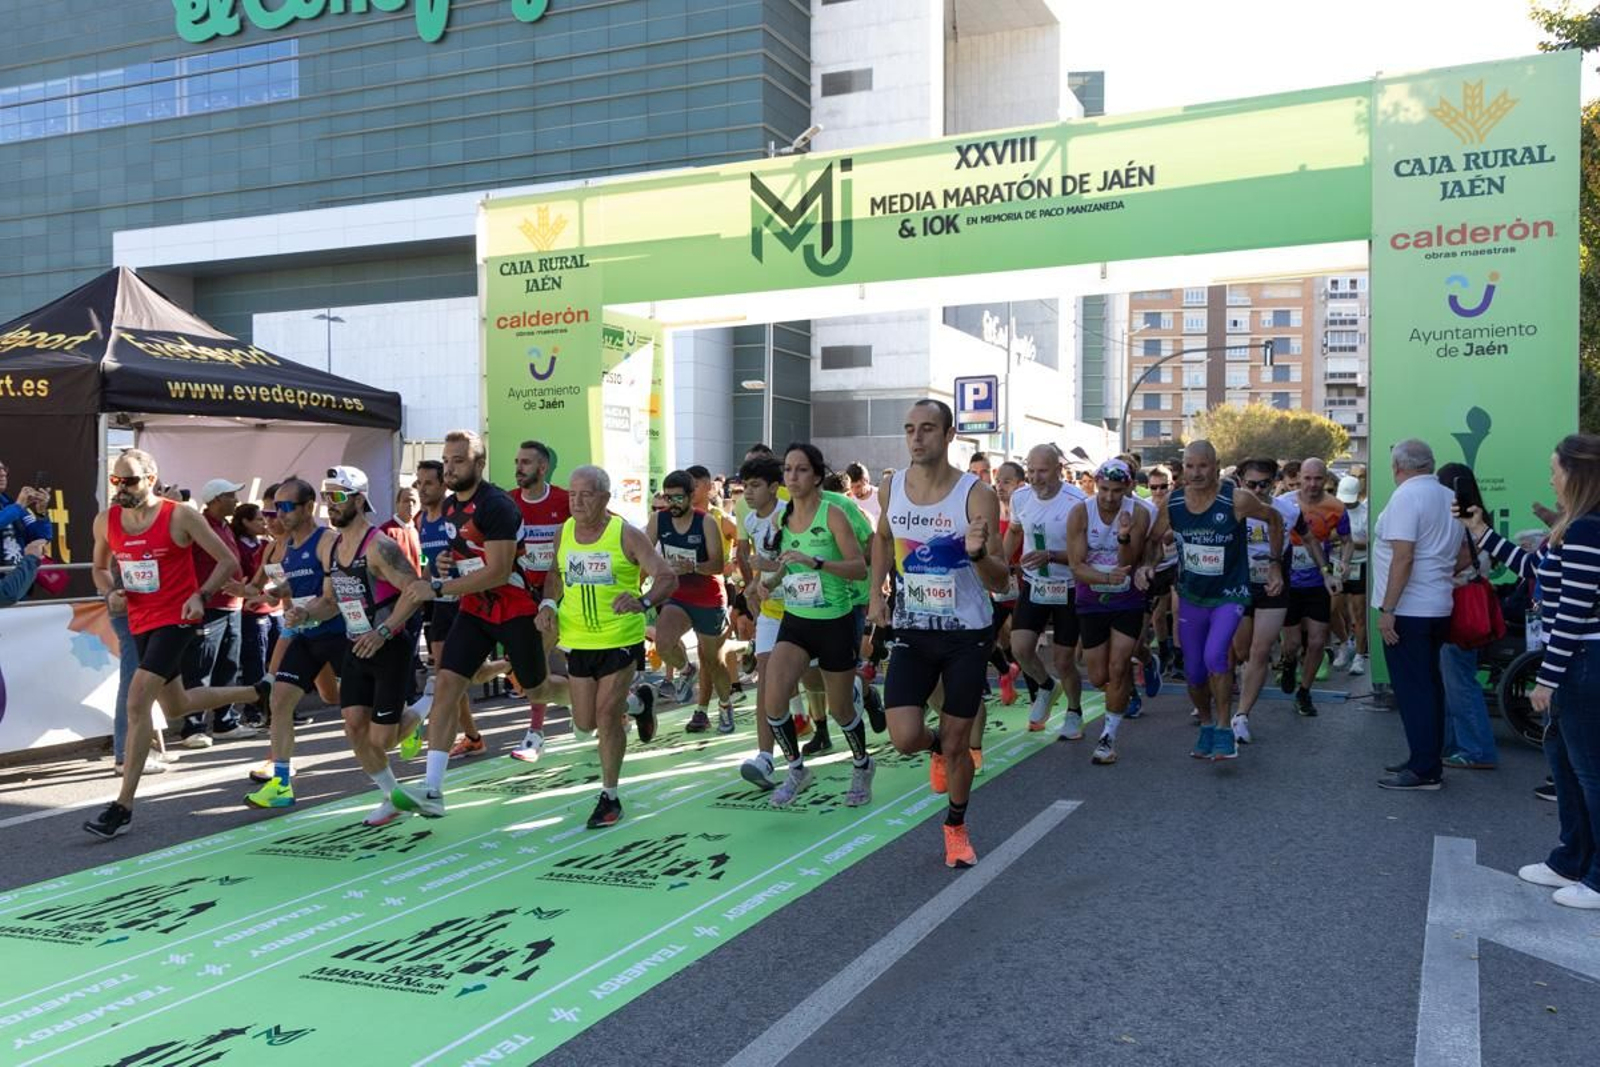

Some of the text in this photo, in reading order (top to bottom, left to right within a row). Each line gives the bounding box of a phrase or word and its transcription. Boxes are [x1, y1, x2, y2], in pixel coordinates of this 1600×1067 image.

[955, 136, 1037, 170] XXVIII
[1394, 145, 1556, 178] CAJA RURAL
[870, 162, 1155, 217] MEDIA MARATÓN DE JAÉN
[1440, 175, 1506, 201] JAÉN
[899, 221, 916, 239] &
[966, 216, 979, 226] EN
[980, 212, 1023, 225] MEMORIA
[1025, 211, 1037, 219] DE
[1039, 207, 1064, 218] PACO
[1066, 201, 1125, 216] MANZANEDA
[1390, 218, 1554, 252] calderón
[1424, 246, 1516, 261] obras maestras
[499, 254, 589, 277] CAJA RURAL
[525, 275, 562, 293] JAÉN
[496, 306, 590, 330] calderón
[1409, 323, 1538, 345] Ayuntamiento
[1436, 341, 1508, 359] de Jaén
[508, 384, 580, 399] Ayuntamiento
[524, 397, 565, 410] de Jaén
[892, 511, 952, 531] calderón
[588, 562, 607, 571] 775
[798, 583, 817, 593] 977
[926, 588, 952, 598] 1061
[589, 944, 689, 1000] TEAMERGY
[14, 985, 175, 1050] TEAMERGY
